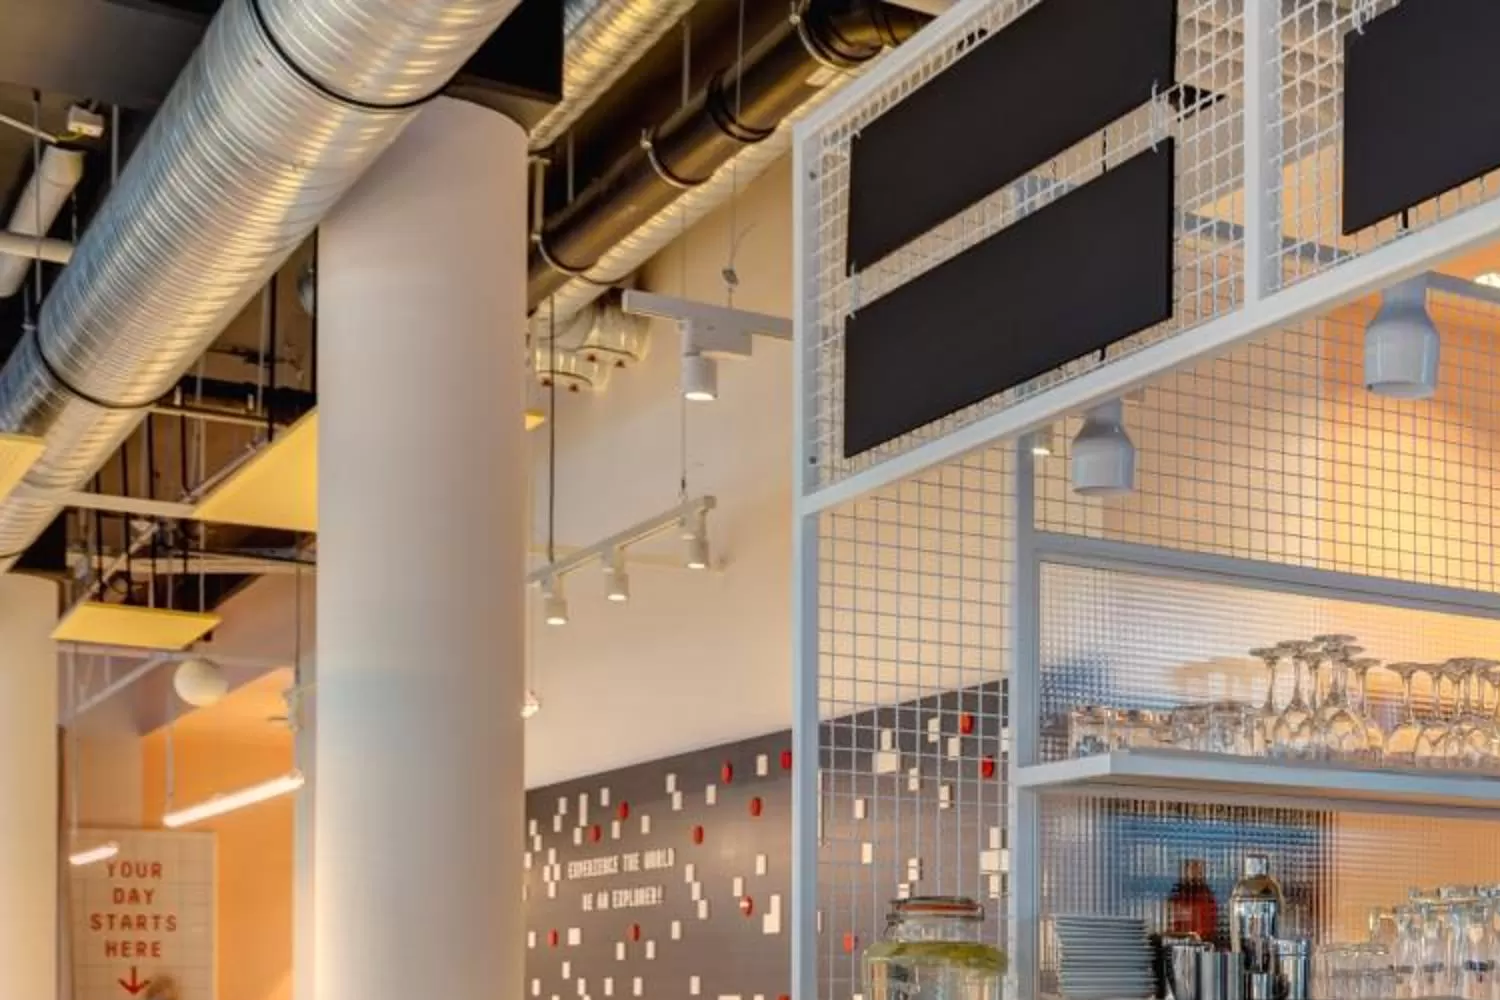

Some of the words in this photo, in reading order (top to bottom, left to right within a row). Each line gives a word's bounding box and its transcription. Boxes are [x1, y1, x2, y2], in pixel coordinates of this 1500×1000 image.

[623, 852, 640, 872] THE
[644, 847, 675, 869] WORLD
[106, 861, 163, 879] YOUR
[113, 887, 155, 905] DAY
[582, 892, 593, 912] BE
[597, 889, 609, 909] AN
[89, 913, 178, 932] STARTS
[104, 940, 161, 958] HERE
